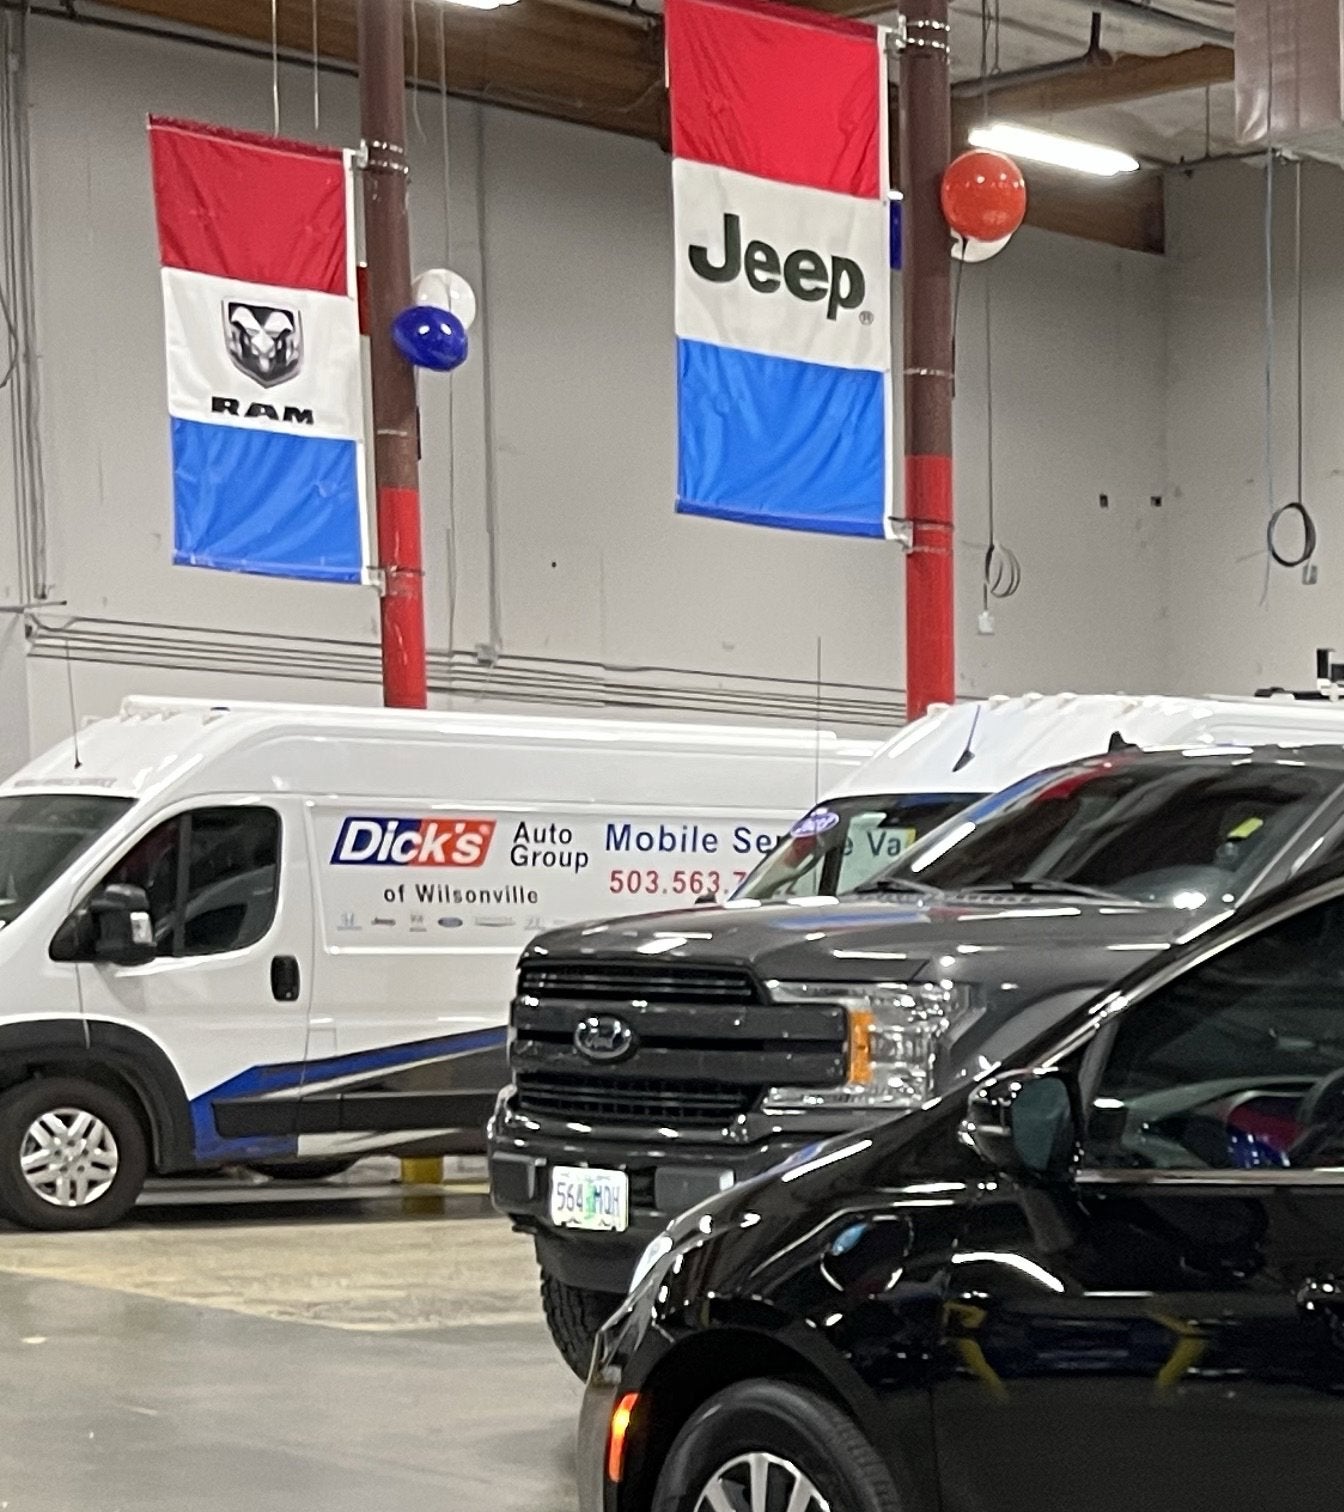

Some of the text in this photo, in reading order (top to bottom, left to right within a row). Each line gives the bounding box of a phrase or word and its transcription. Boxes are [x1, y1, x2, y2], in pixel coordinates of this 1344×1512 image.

[688, 212, 866, 321] Jeep
[211, 396, 314, 425] RAM
[338, 820, 485, 864] Dick's
[513, 821, 573, 845] Auto
[606, 823, 718, 853] Mobile
[510, 844, 589, 874] Group
[384, 884, 538, 904] of Wilsonville
[557, 1182, 583, 1212] 564
